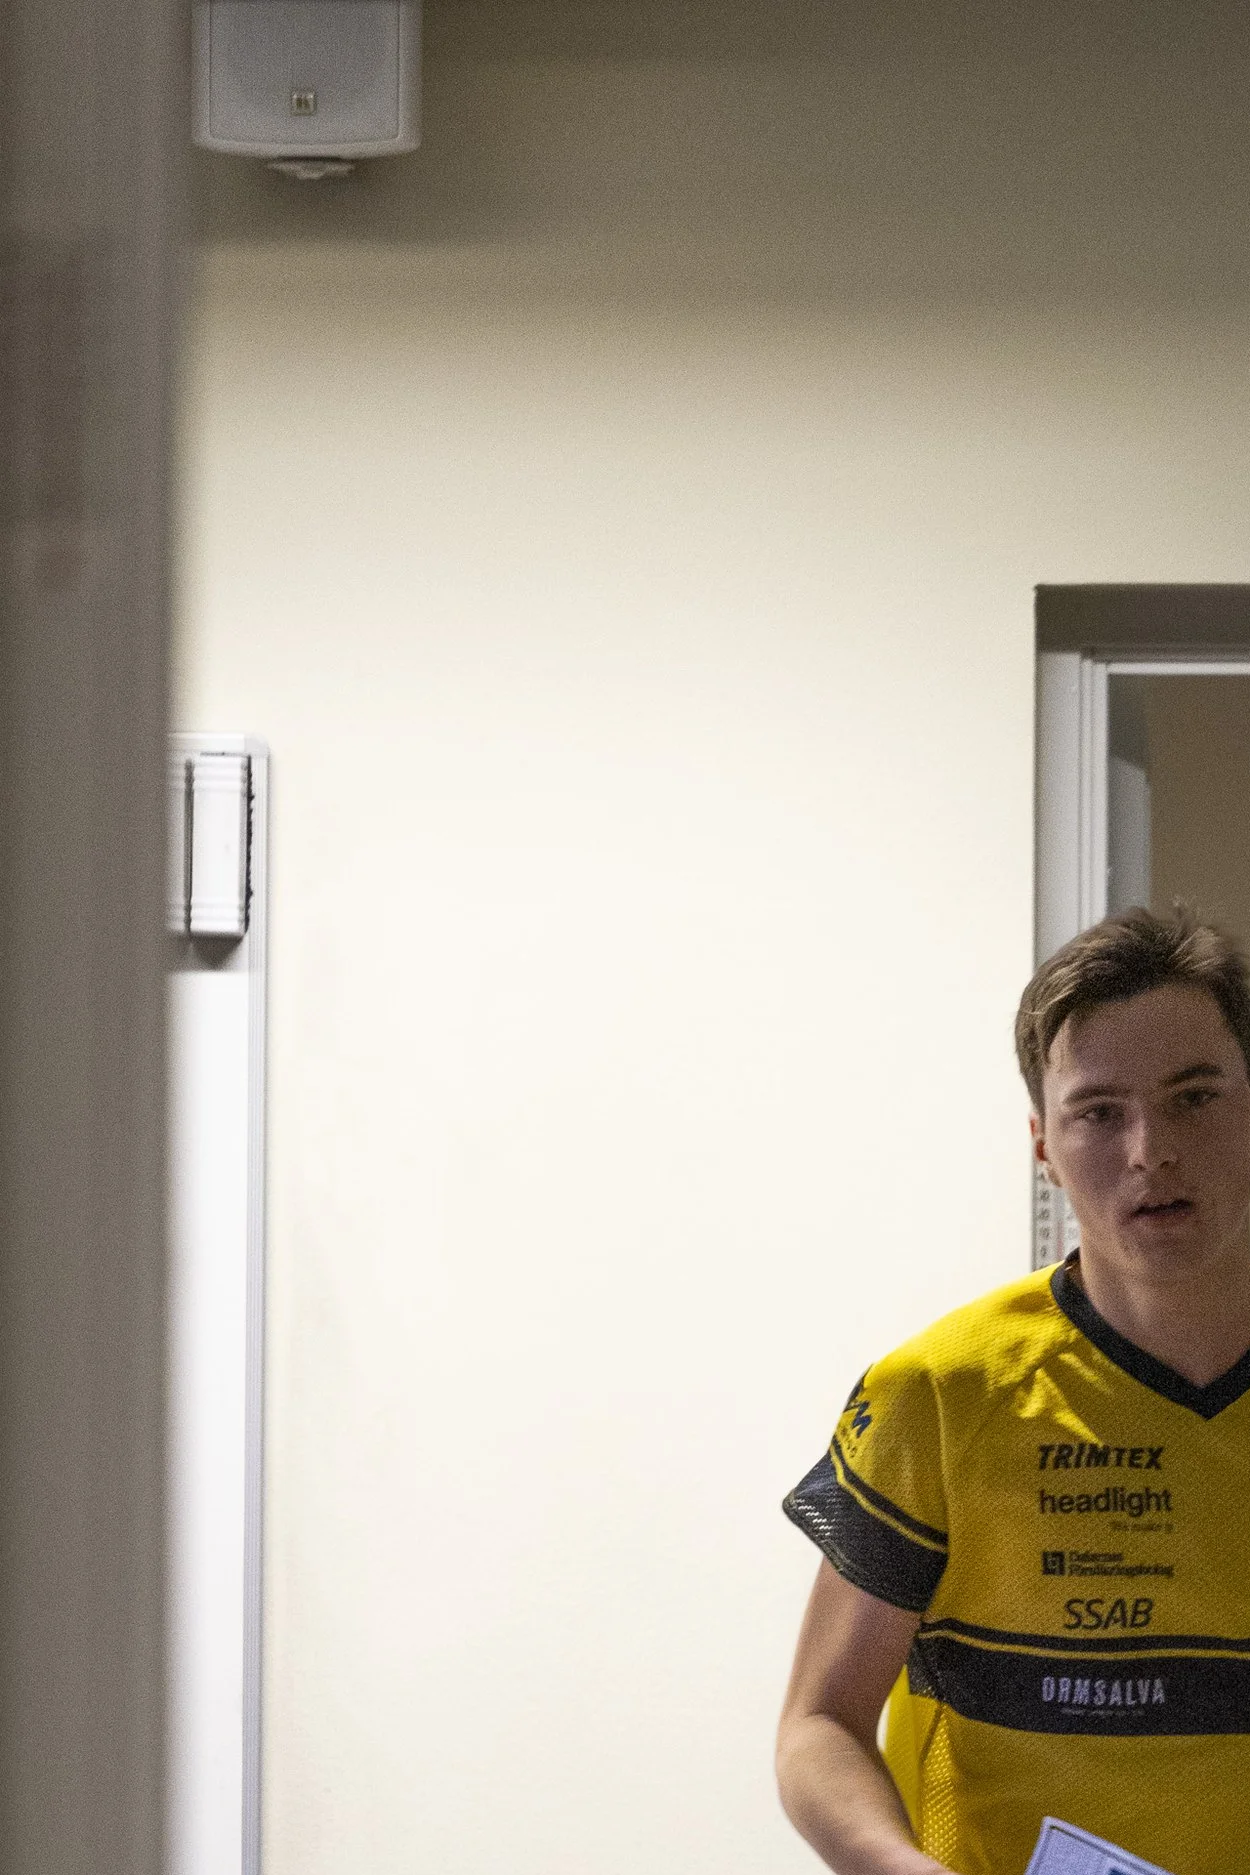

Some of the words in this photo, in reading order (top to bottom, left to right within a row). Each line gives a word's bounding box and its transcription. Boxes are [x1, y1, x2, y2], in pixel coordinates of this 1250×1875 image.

[1038, 1443, 1164, 1471] TRIMTEX
[1039, 1487, 1172, 1517] headlight
[1063, 1598, 1154, 1631] SSAB
[1042, 1676, 1166, 1706] ORMSALVA
